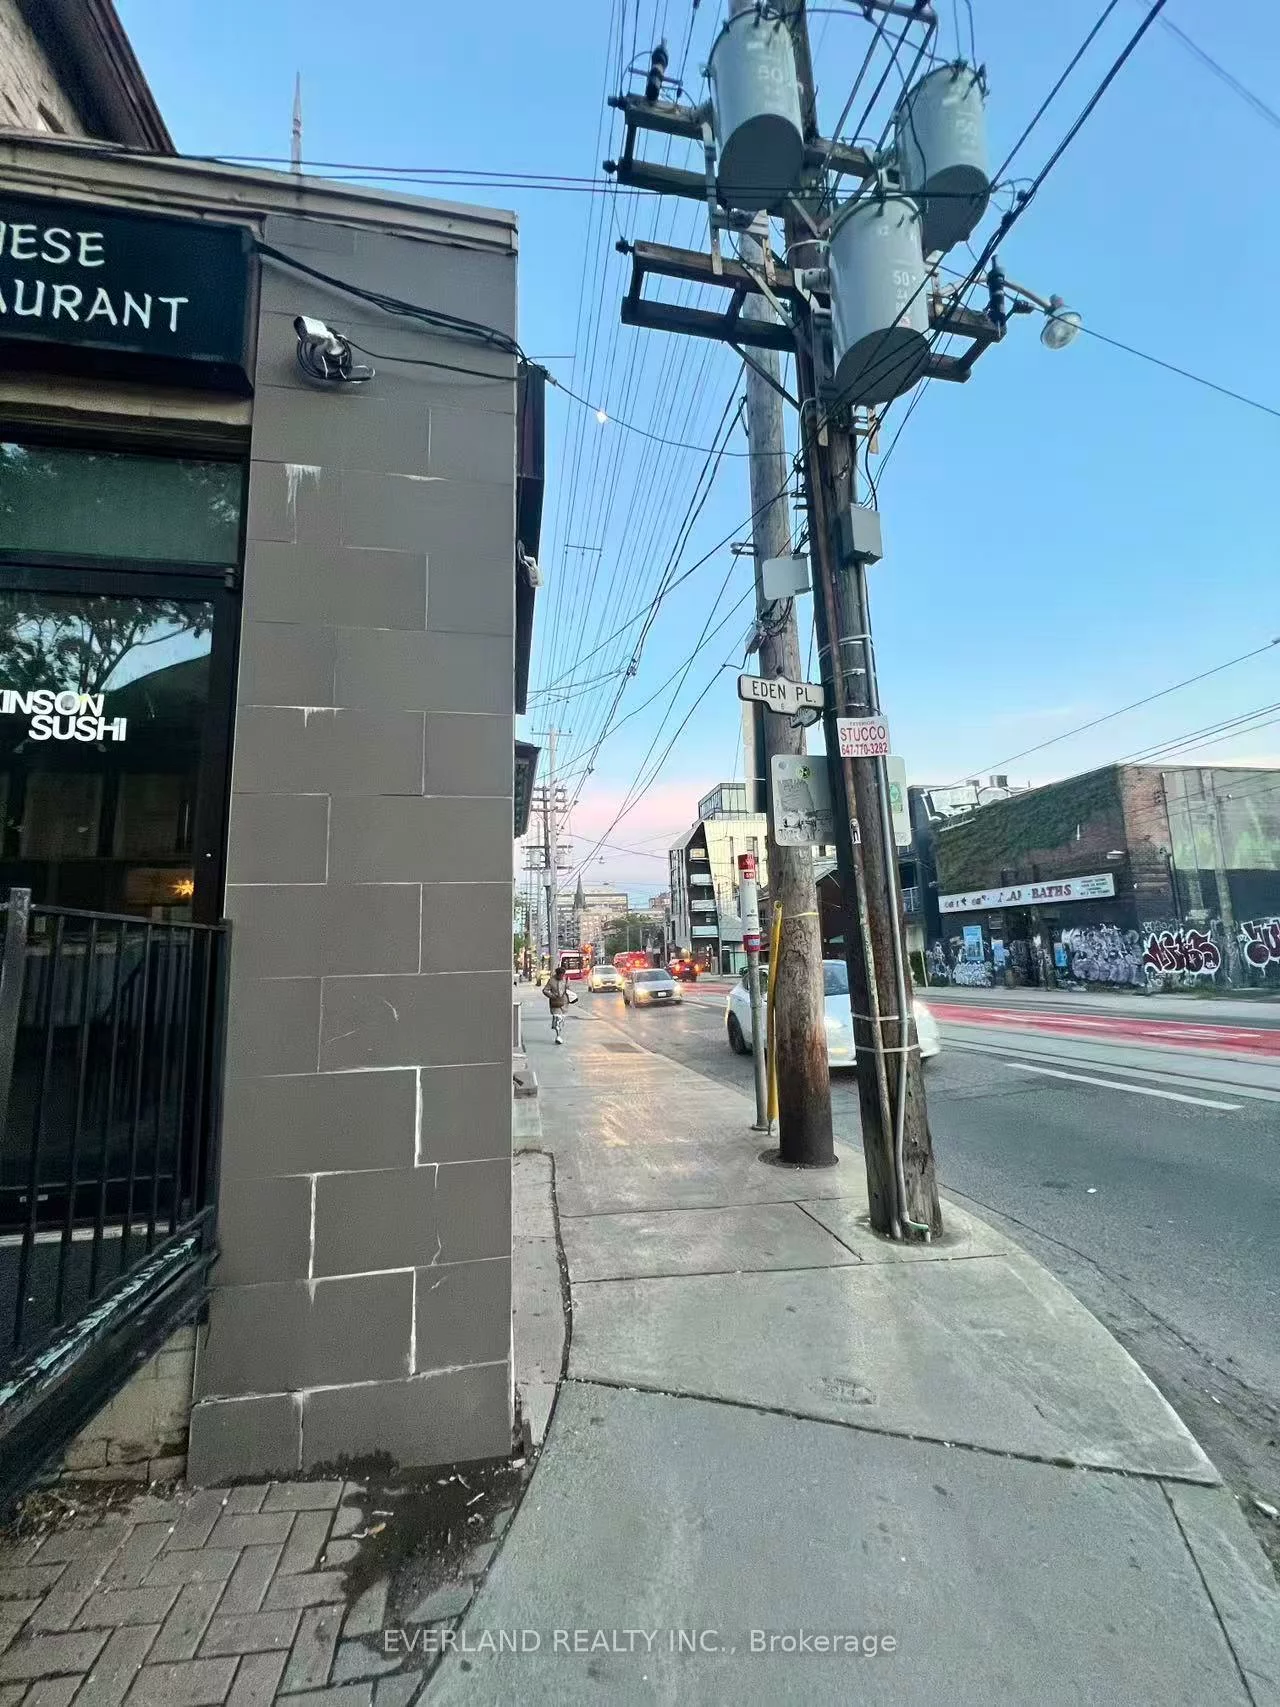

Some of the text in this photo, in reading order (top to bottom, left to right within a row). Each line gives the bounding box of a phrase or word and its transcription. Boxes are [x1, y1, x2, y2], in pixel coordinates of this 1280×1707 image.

[0, 220, 105, 267] ESE
[752, 680, 817, 703] EDEN PL.
[28, 715, 127, 741] SUSHI
[840, 725, 886, 741] STUCCO
[1032, 884, 1072, 899] BATHS
